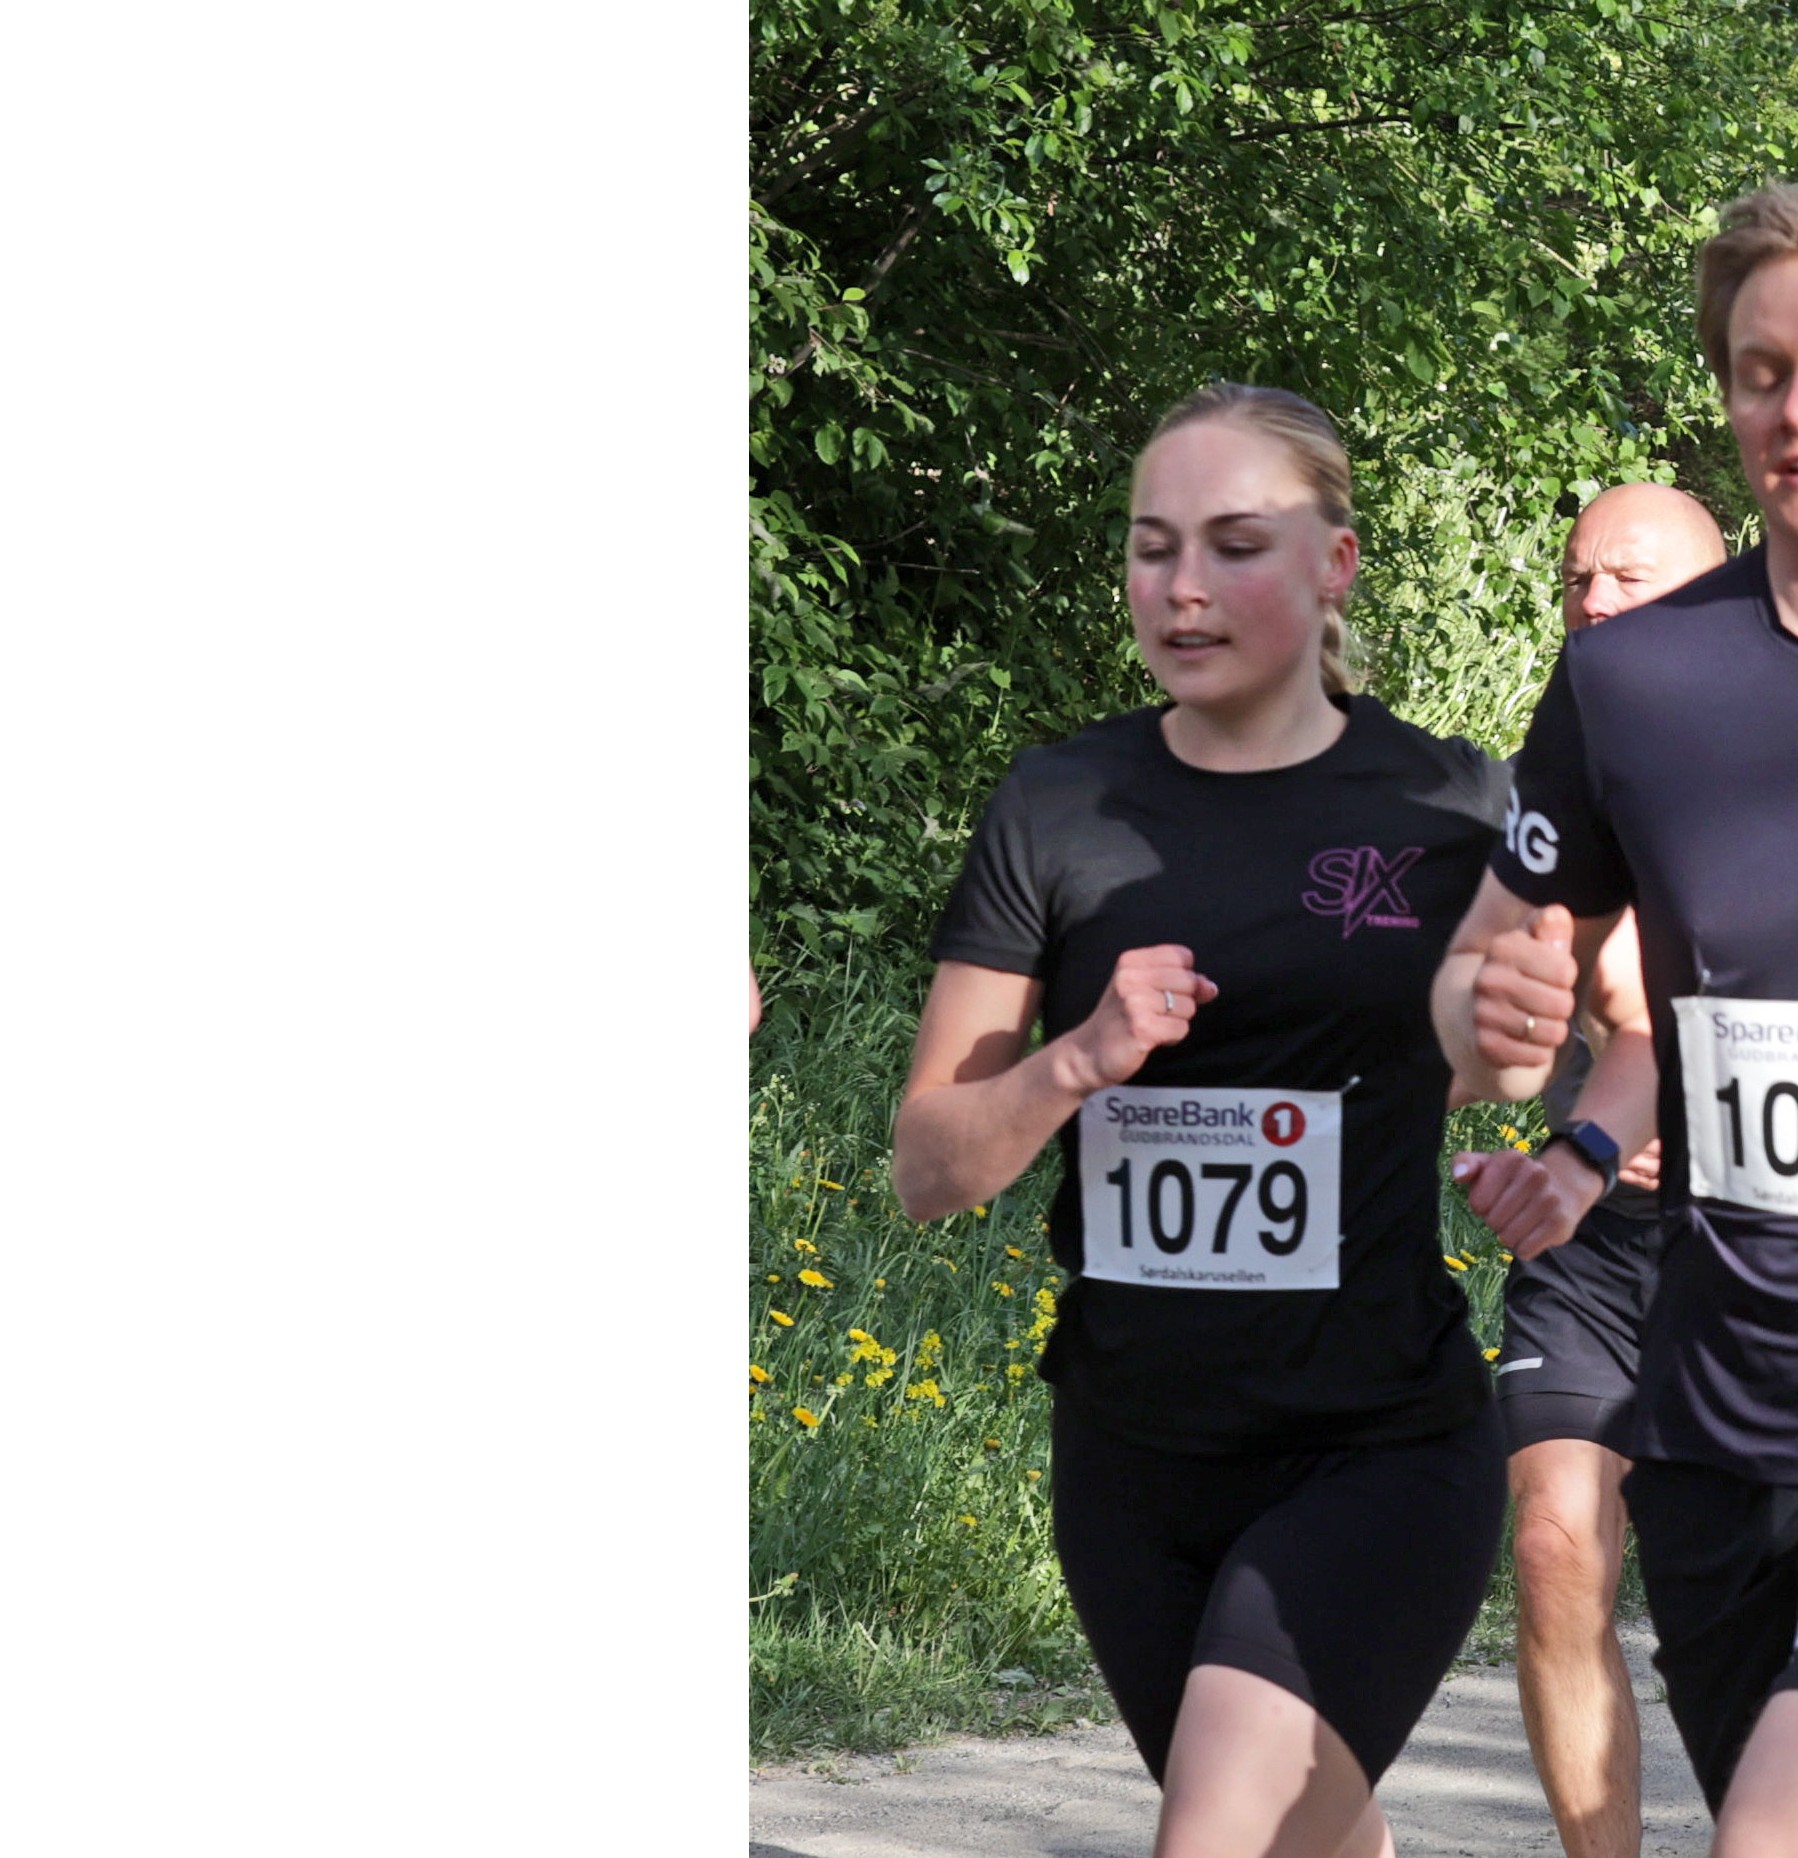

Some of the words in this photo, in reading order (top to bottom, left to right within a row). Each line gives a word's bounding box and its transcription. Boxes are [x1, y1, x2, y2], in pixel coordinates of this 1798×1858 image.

[1105, 1097, 1255, 1128] SpareBank
[1119, 1130, 1256, 1147] GUDBRANDSDAL
[1106, 1157, 1309, 1257] 1079
[1139, 1265, 1267, 1284] Sørdalskarusellen
